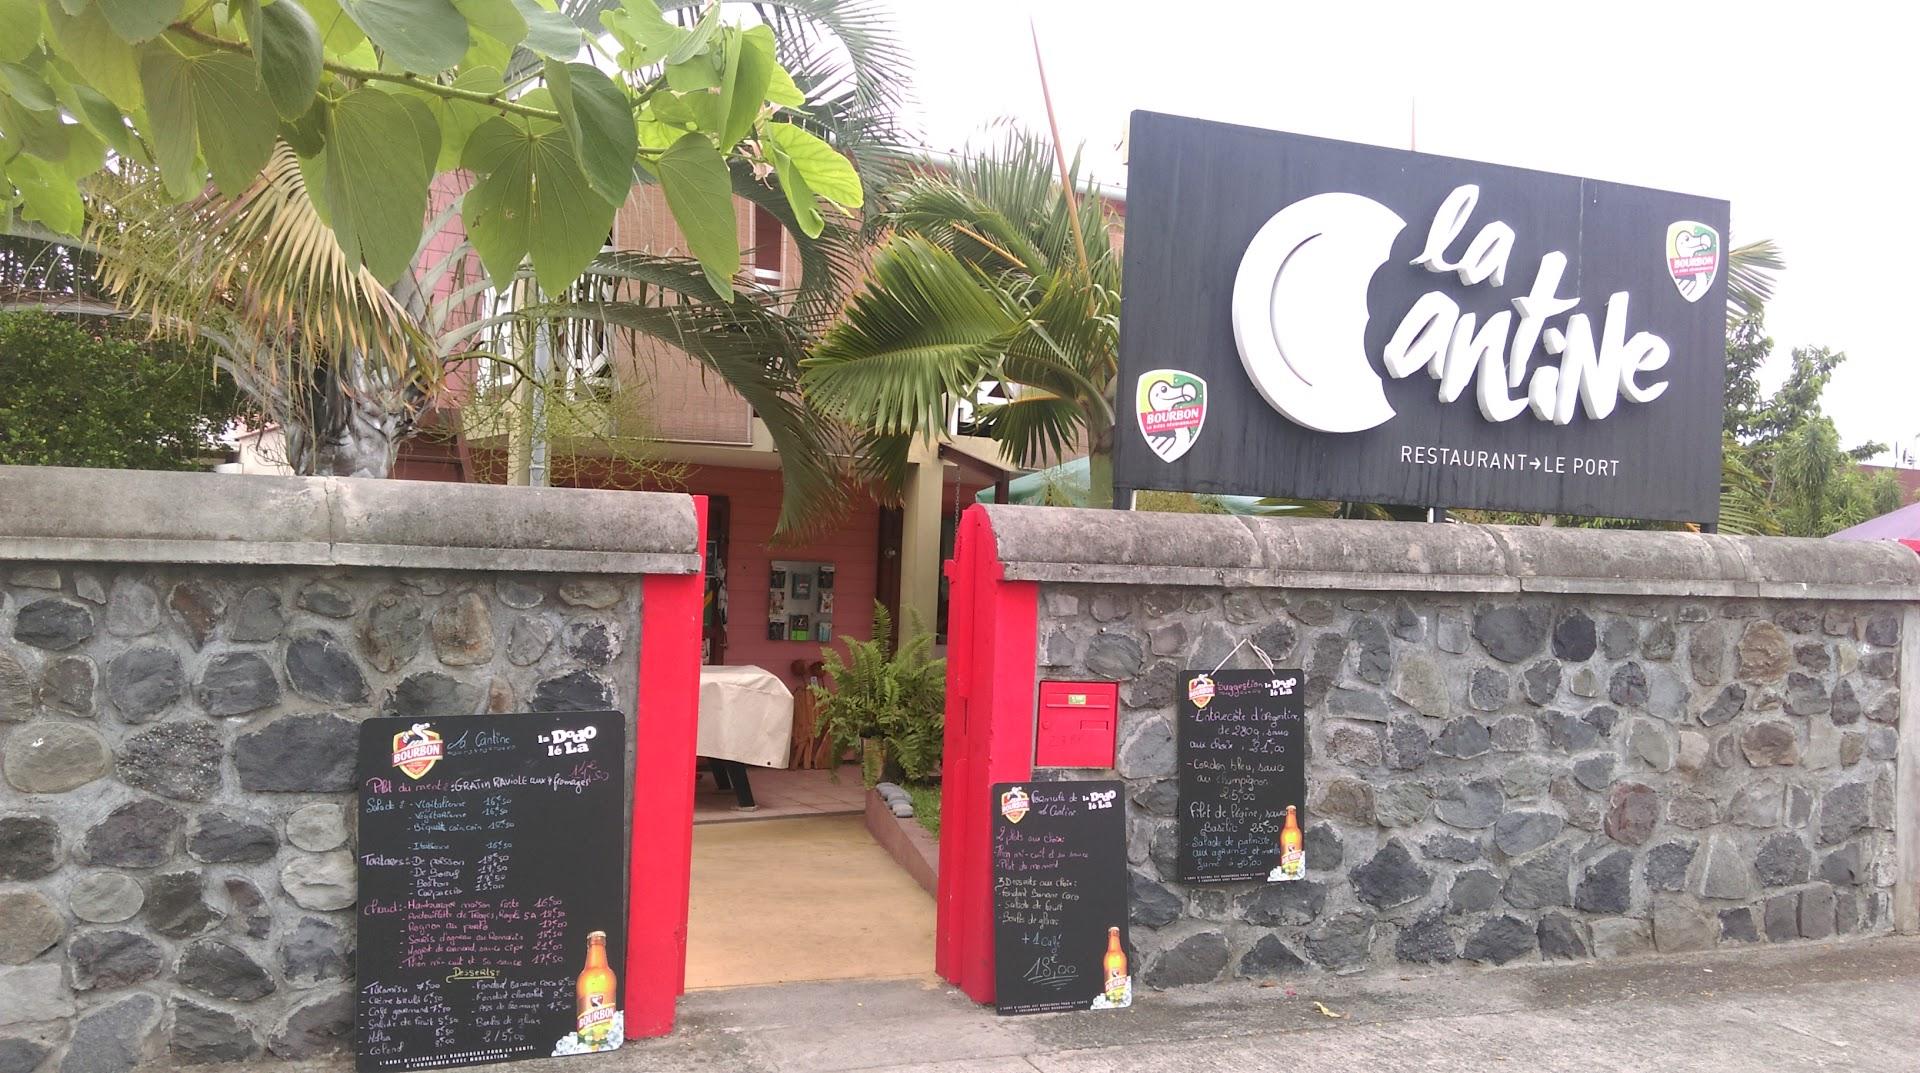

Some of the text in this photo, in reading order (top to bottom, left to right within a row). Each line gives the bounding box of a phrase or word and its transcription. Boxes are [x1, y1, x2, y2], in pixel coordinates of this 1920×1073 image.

[1409, 183, 1515, 287] la
[1146, 408, 1199, 425] BOURBON
[1401, 445, 1620, 476] RESTAURANT LE PORT
[1217, 680, 1265, 695] Suggestion
[474, 728, 510, 748] Cantine
[1218, 726, 1229, 735] de
[393, 743, 440, 763] BOURBON
[564, 742, 590, 755] La
[1197, 774, 1211, 783] au
[398, 782, 411, 793] du
[1189, 802, 1211, 819] Filet
[1215, 804, 1227, 818] de
